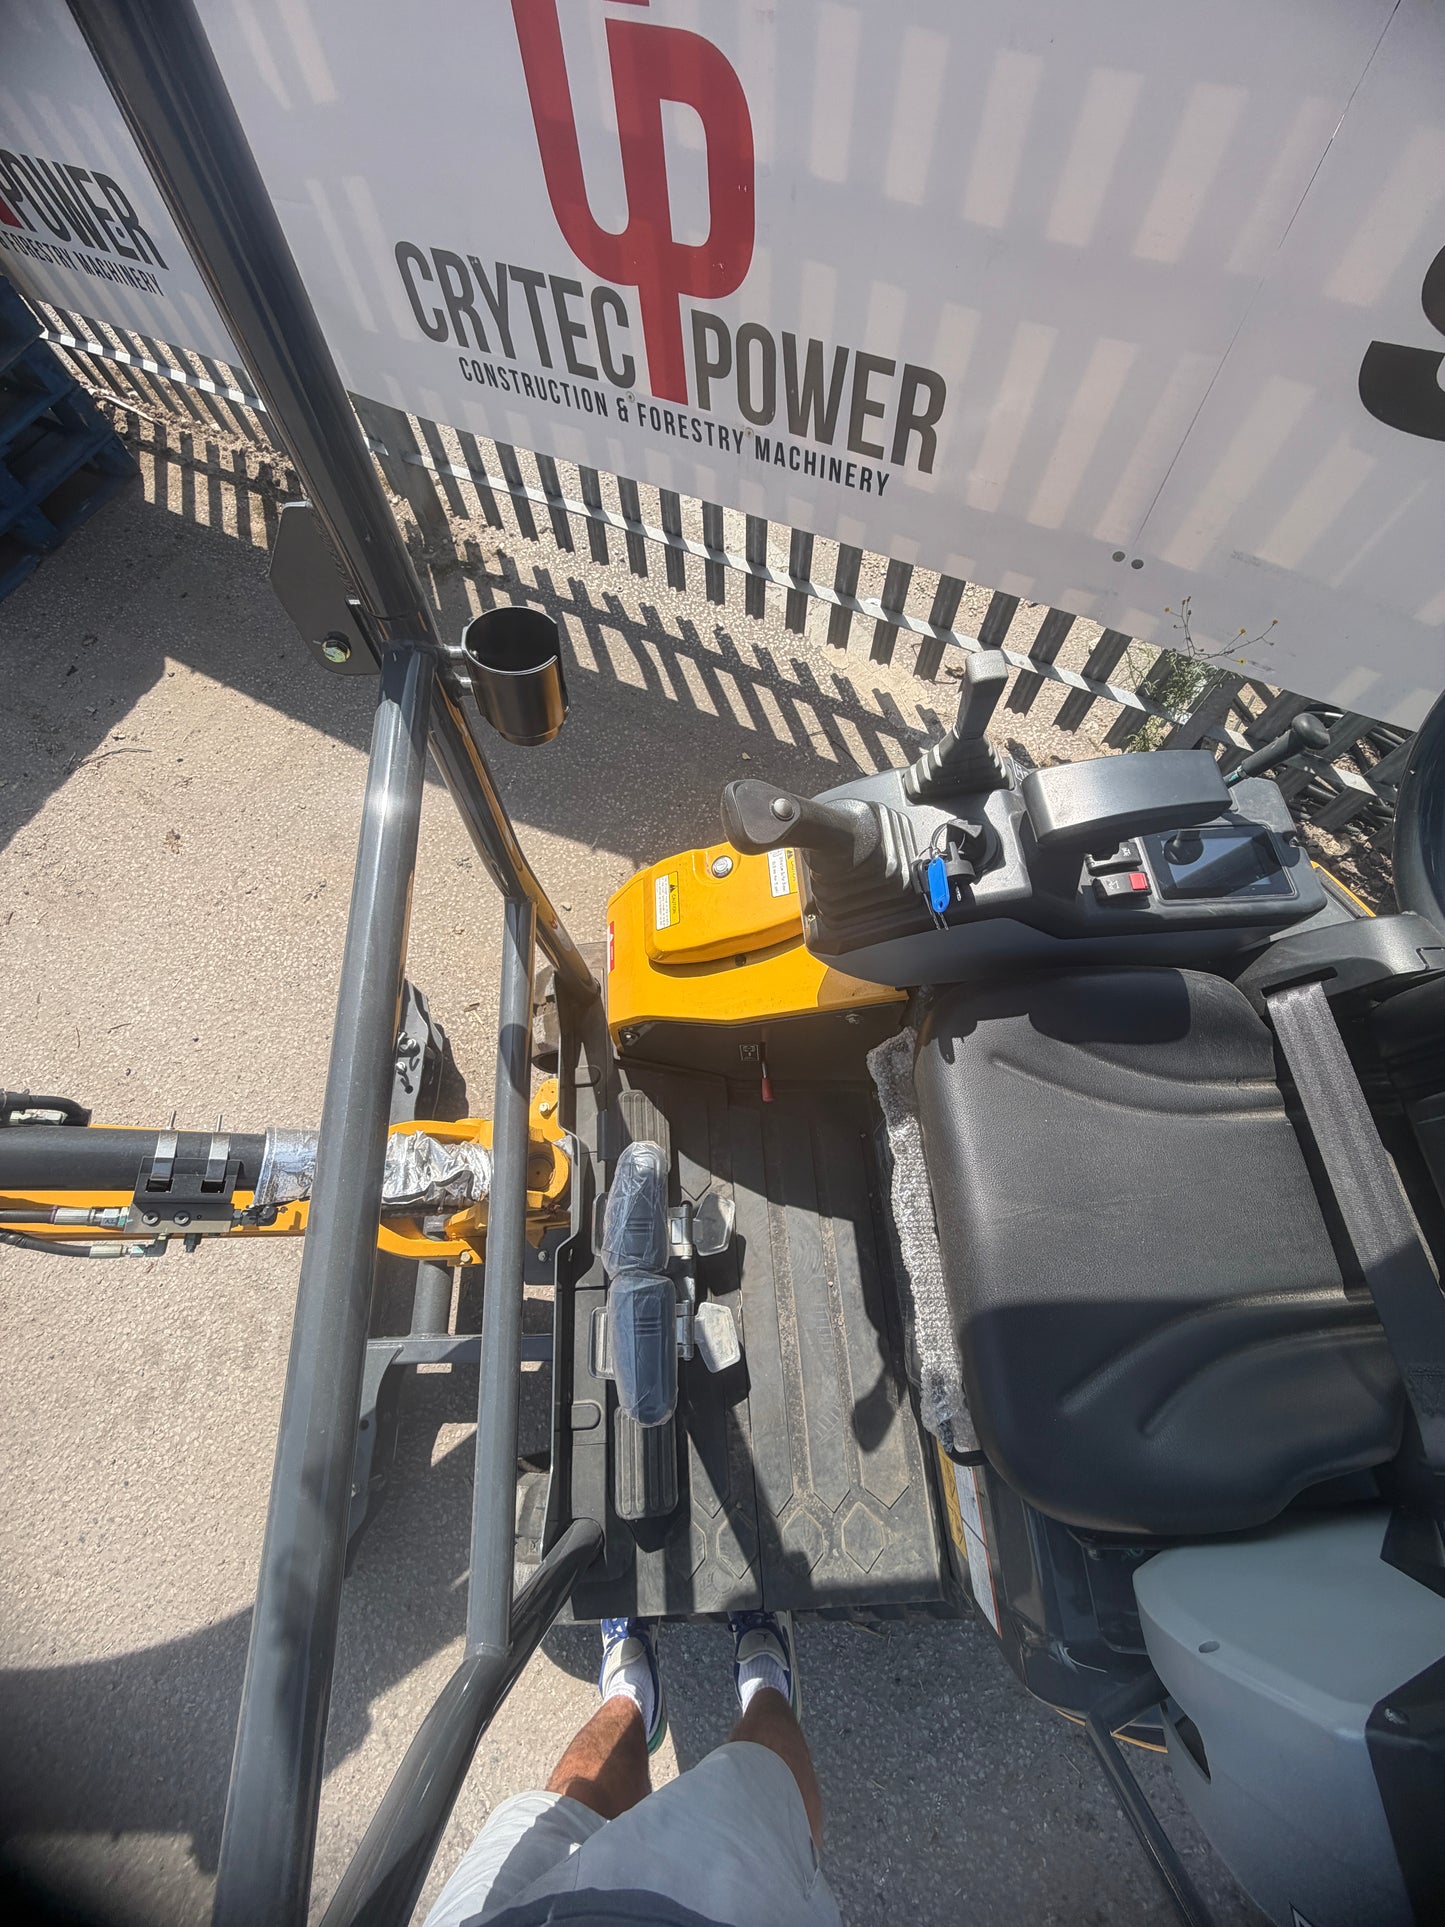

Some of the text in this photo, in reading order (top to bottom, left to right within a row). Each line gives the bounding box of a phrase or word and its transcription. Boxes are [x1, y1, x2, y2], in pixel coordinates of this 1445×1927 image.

[1, 230, 165, 297] FORESTRY MACHINERY
[394, 240, 947, 475] CRYTEC POWER
[458, 356, 890, 497] CONSTRUCTION & FORESTRY MACHINERY
